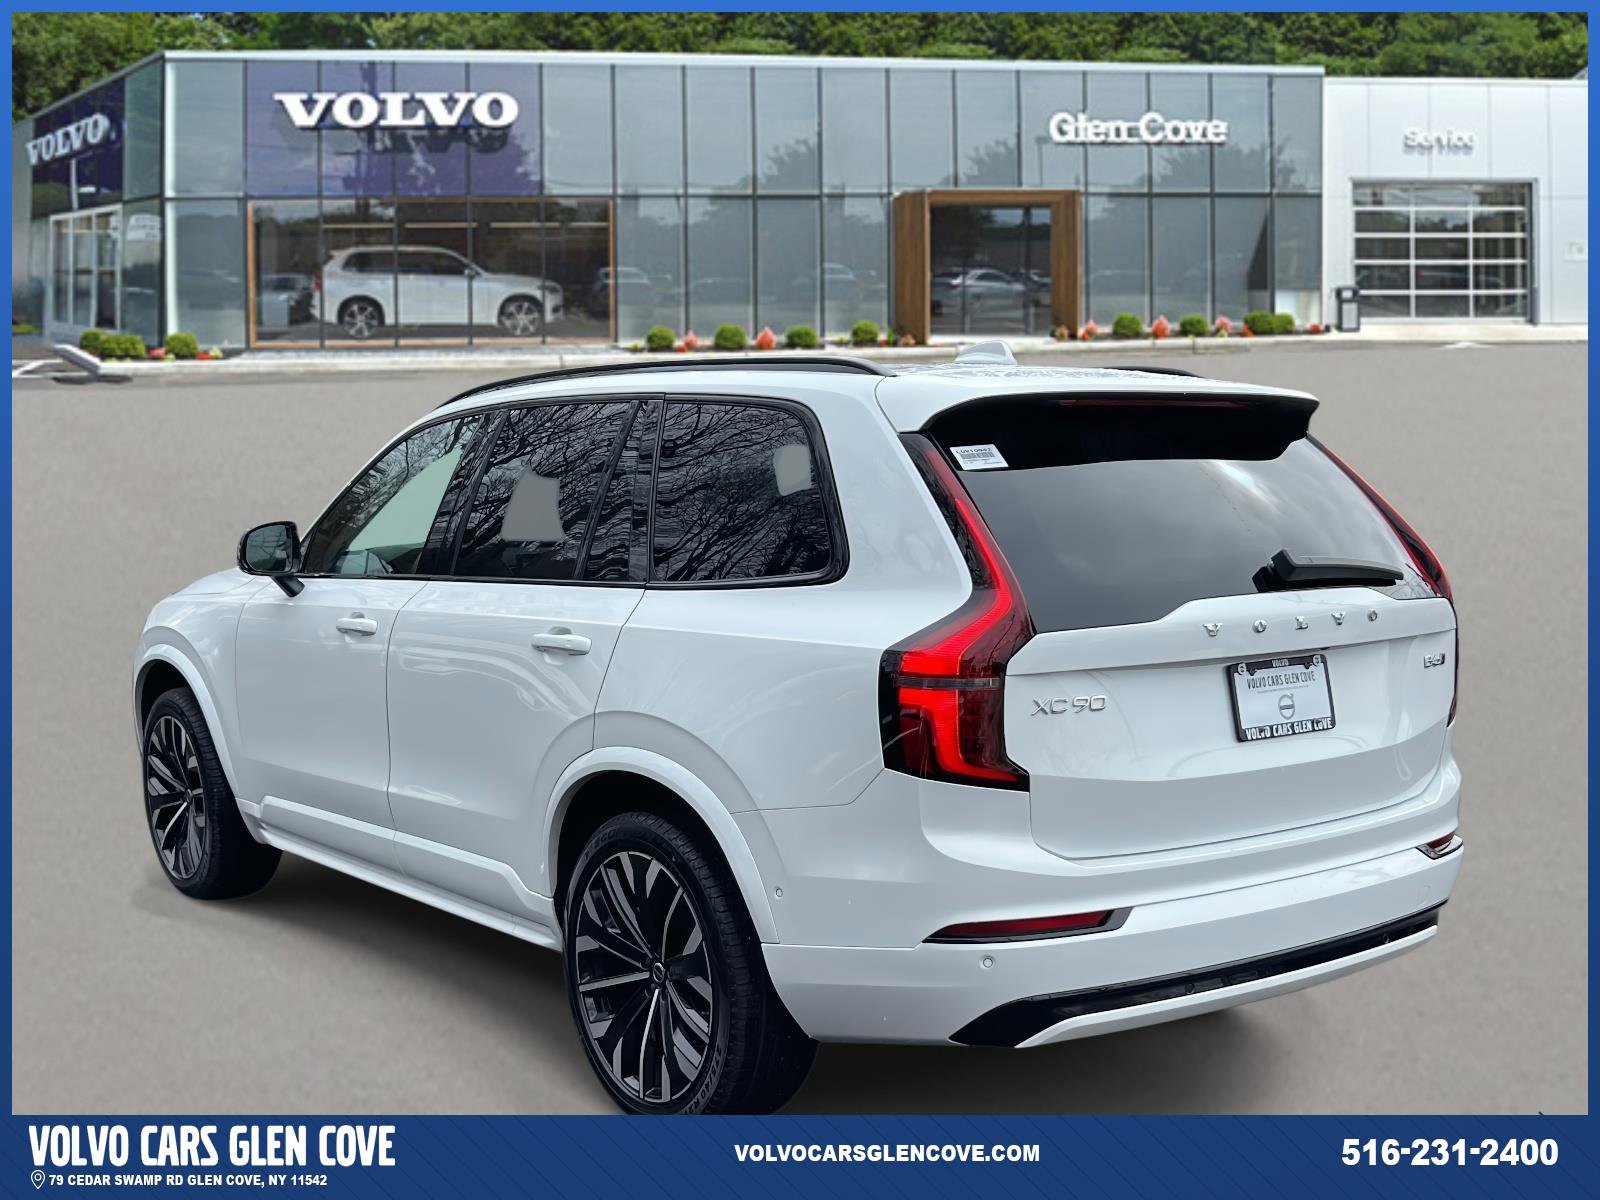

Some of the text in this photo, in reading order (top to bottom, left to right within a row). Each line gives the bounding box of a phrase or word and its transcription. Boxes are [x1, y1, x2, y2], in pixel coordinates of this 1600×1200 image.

[273, 92, 519, 127] VOLVO
[26, 113, 110, 165] VOLVO
[1049, 112, 1228, 143] Glen Cove
[1403, 127, 1477, 155] Service
[1203, 608, 1378, 637] VOLVO
[1271, 659, 1289, 668] VOLVO
[1246, 676, 1267, 690] VOLVO
[1267, 674, 1284, 687] CARS
[1284, 673, 1301, 685] GLEN
[1300, 670, 1316, 683] COVE
[1272, 722, 1294, 737] CARS
[1293, 720, 1313, 732] GLEN
